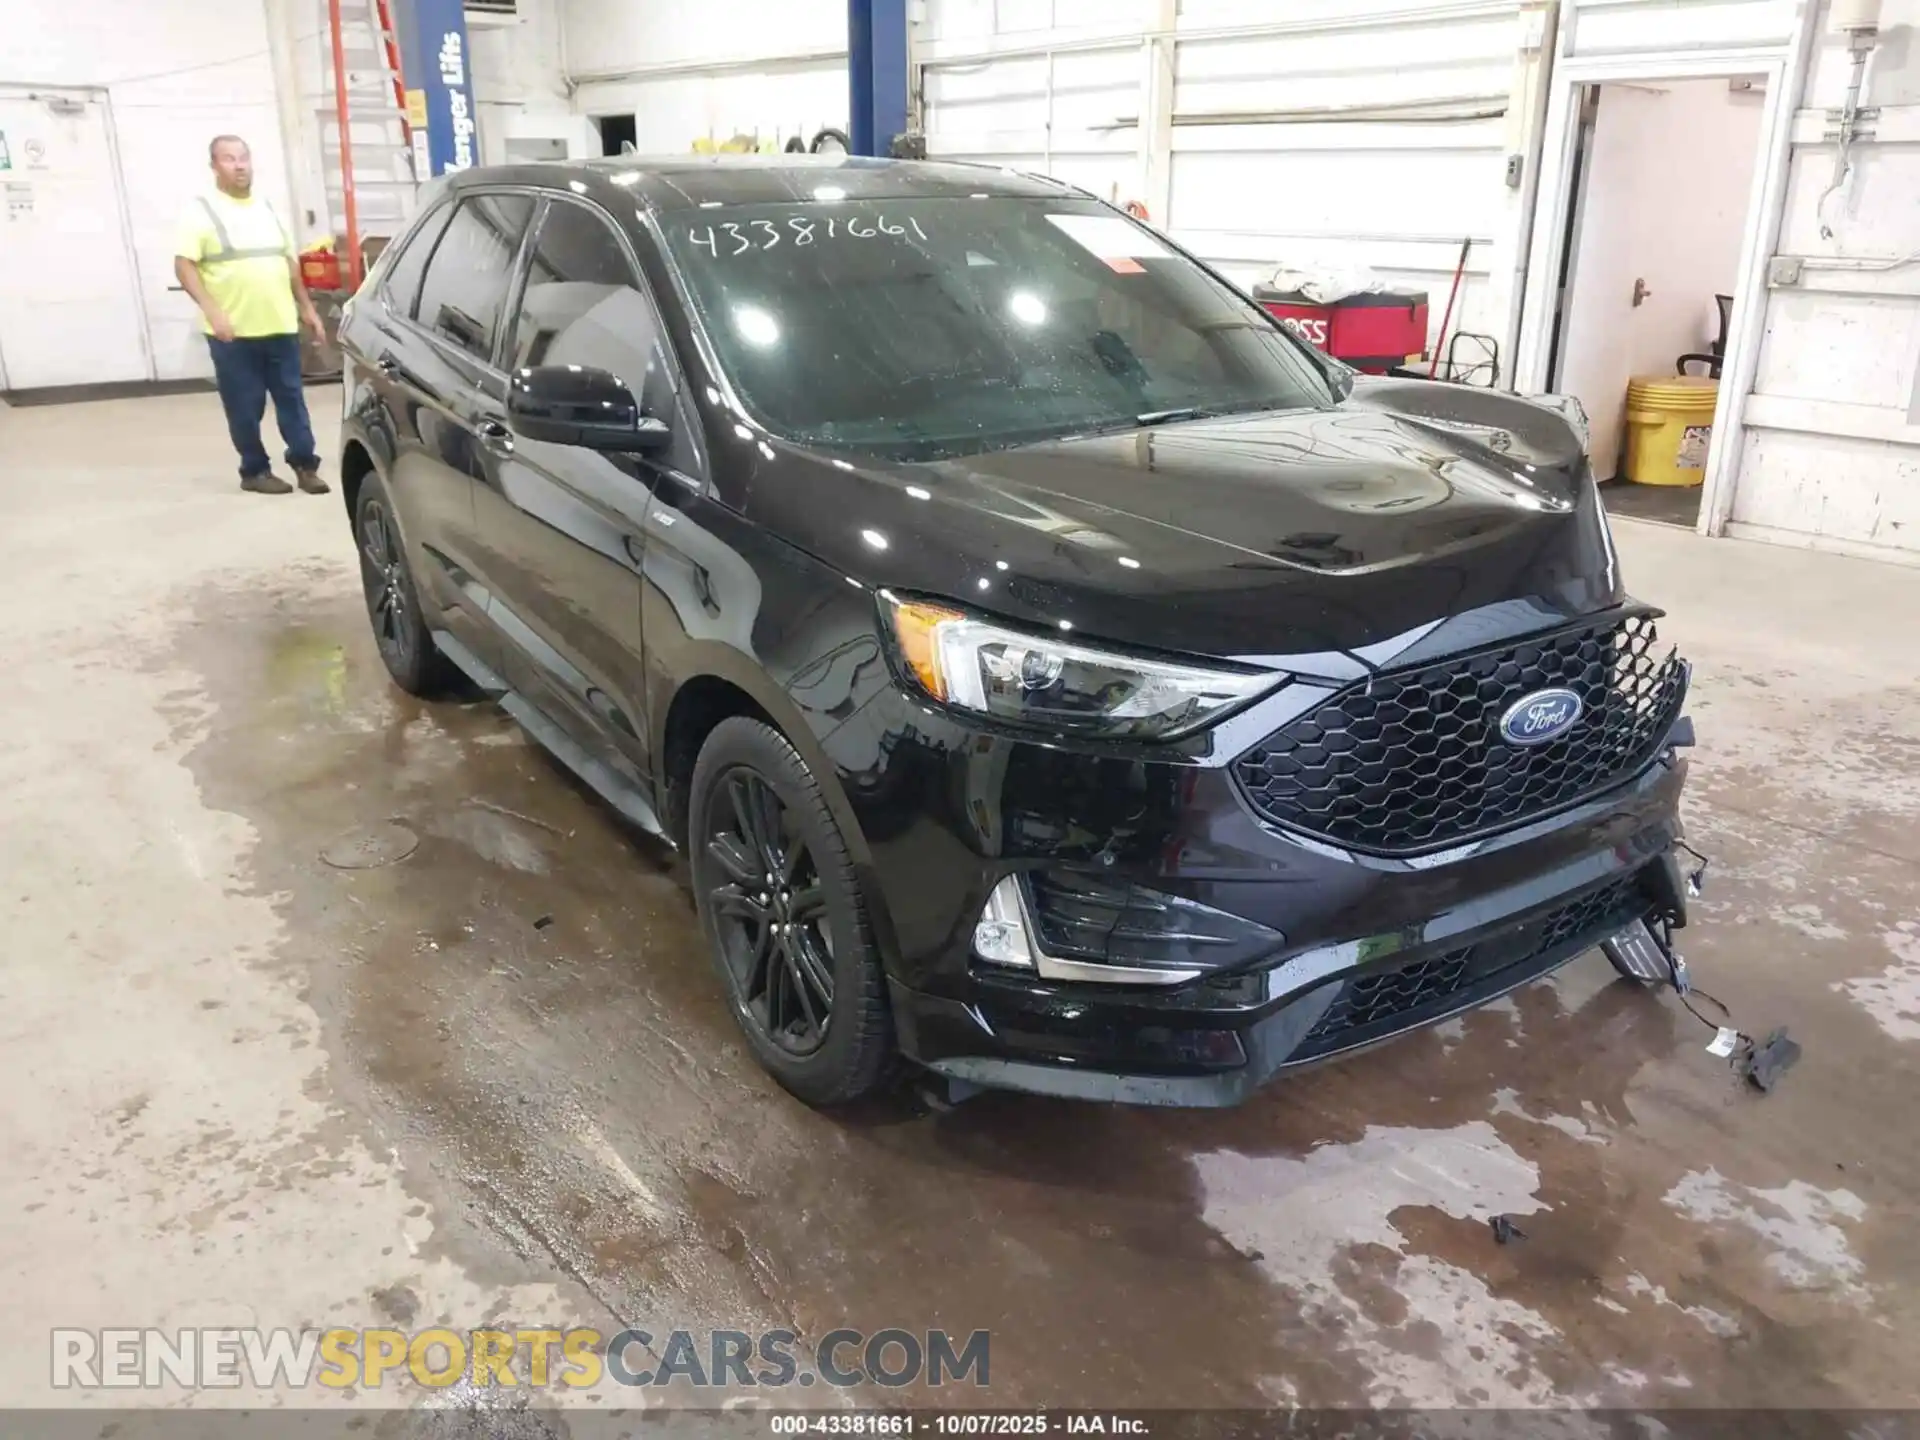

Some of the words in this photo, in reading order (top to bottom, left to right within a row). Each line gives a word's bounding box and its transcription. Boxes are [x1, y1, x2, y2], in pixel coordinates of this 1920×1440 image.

[438, 31, 464, 84] Lifts
[689, 214, 928, 257] 43381661
[1523, 700, 1567, 733] Ford
